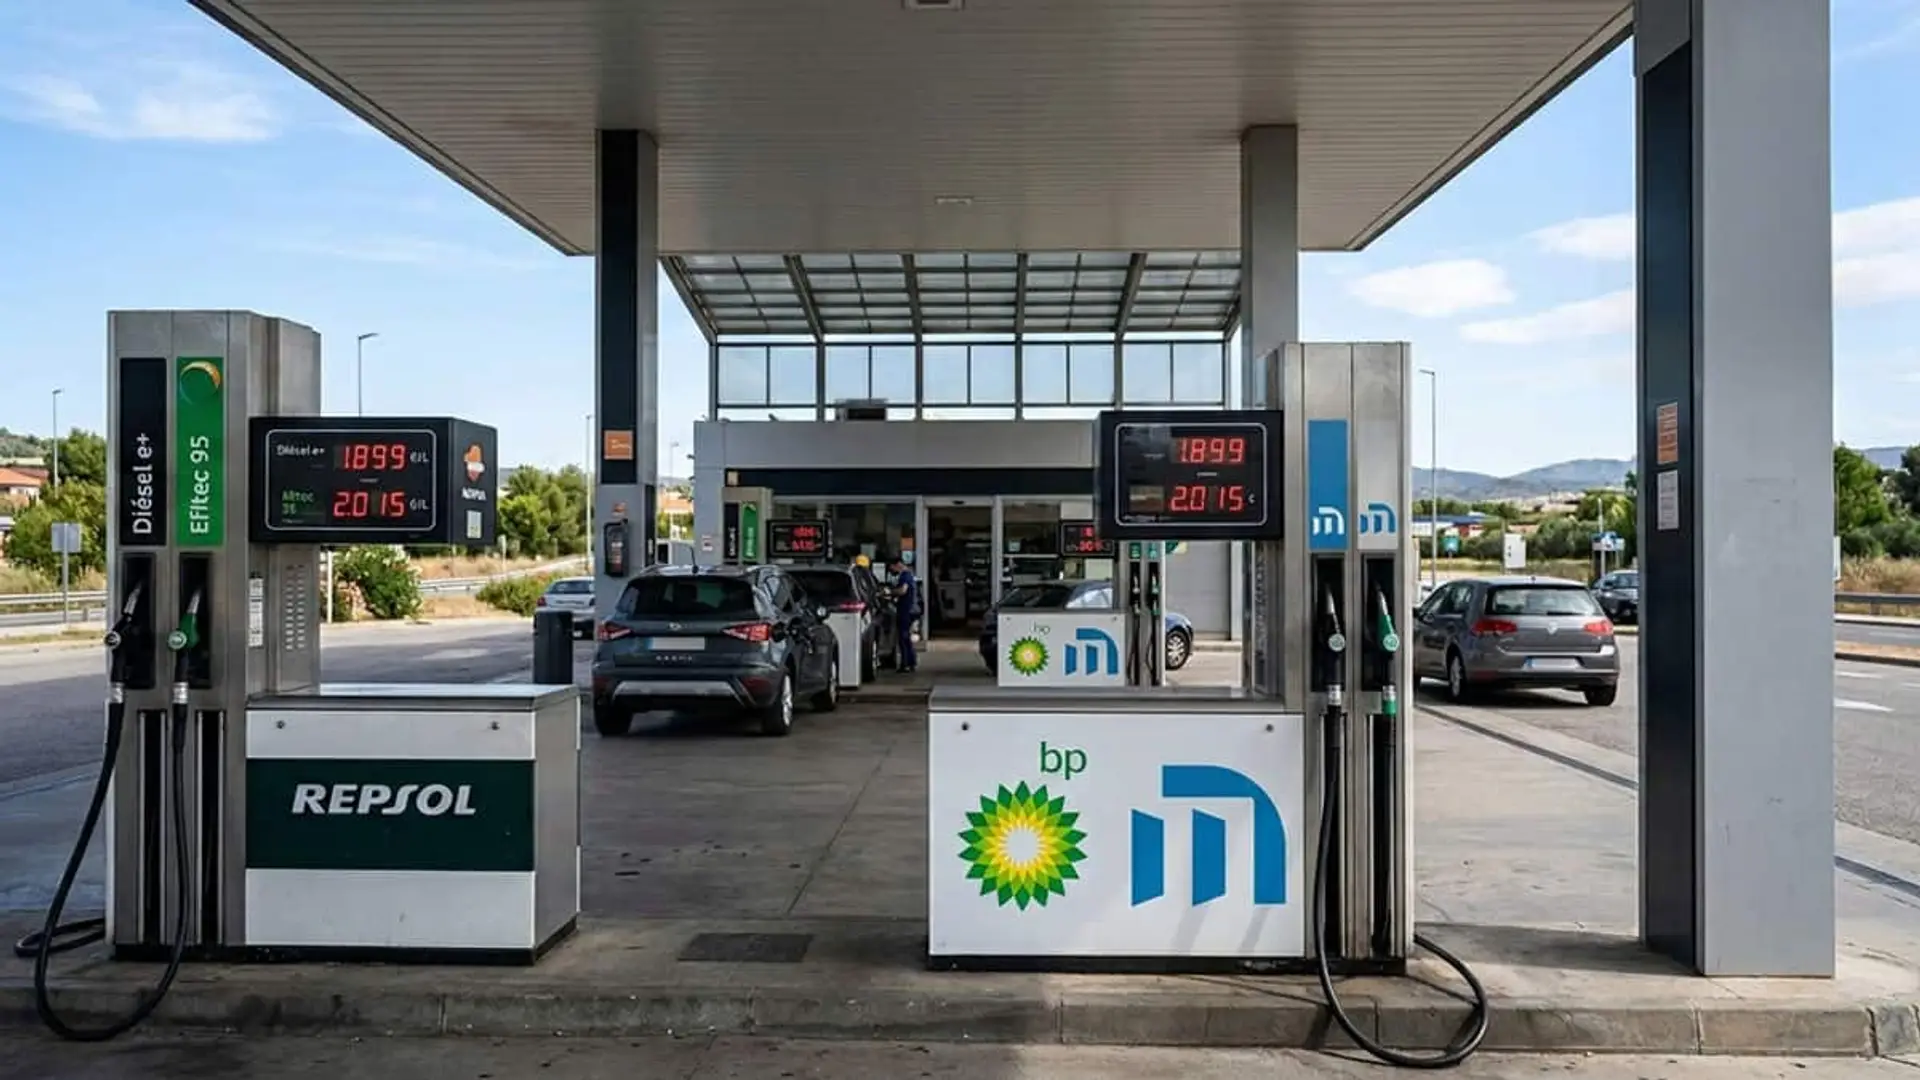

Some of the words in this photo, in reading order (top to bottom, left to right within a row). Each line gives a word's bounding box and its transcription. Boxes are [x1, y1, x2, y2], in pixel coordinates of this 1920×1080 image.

[136, 433, 153, 459] e+
[190, 435, 209, 464] 95
[130, 464, 153, 534] Diésel
[1040, 741, 1087, 779] bp
[292, 784, 477, 816] REPSOL
